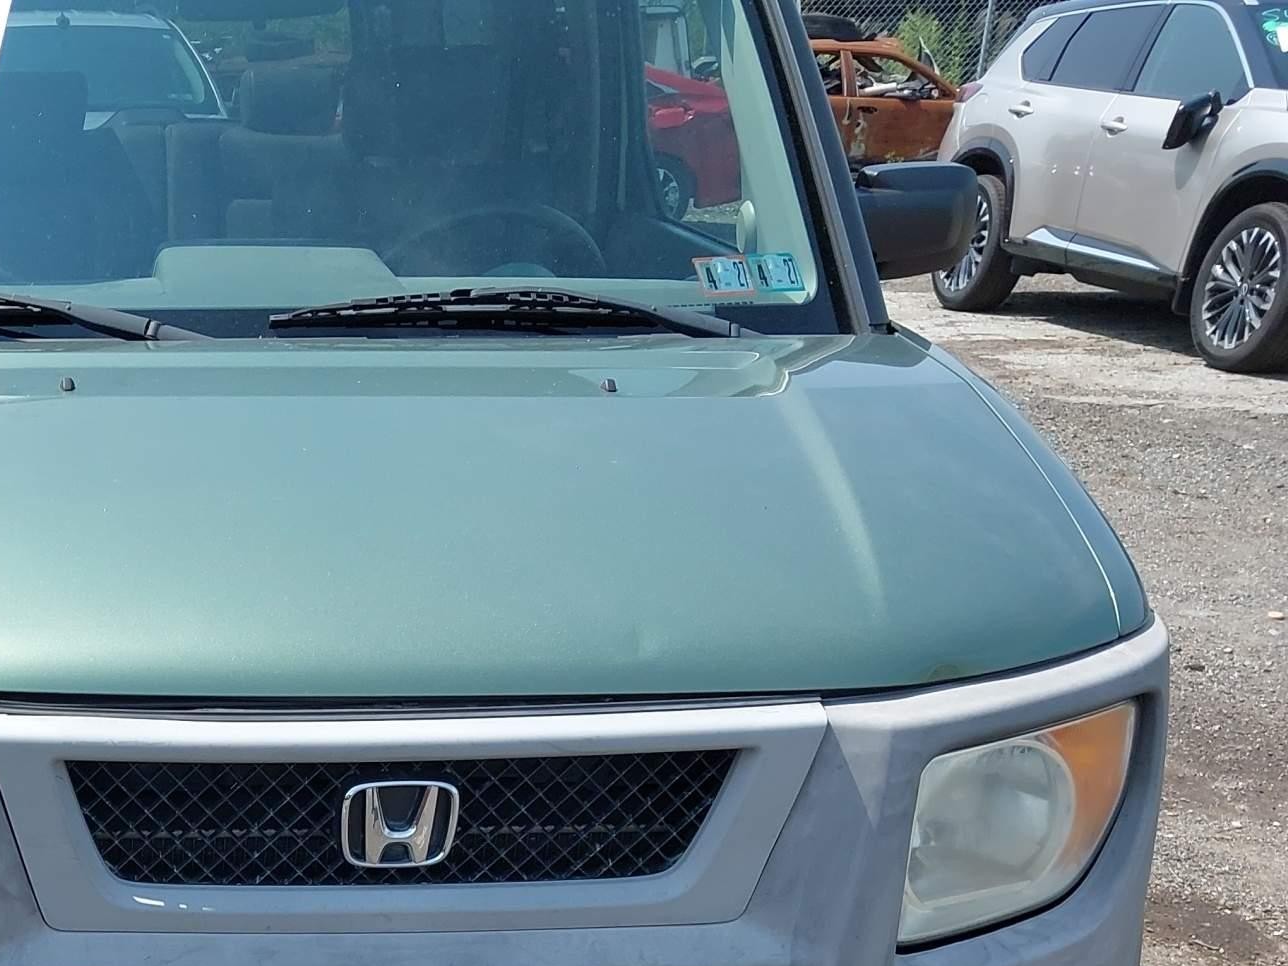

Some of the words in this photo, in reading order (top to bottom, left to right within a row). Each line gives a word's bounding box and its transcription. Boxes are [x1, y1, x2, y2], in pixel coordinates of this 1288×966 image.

[705, 266, 718, 290] 4
[732, 260, 750, 288] 27
[757, 263, 769, 287] 4
[782, 257, 799, 285] 27
